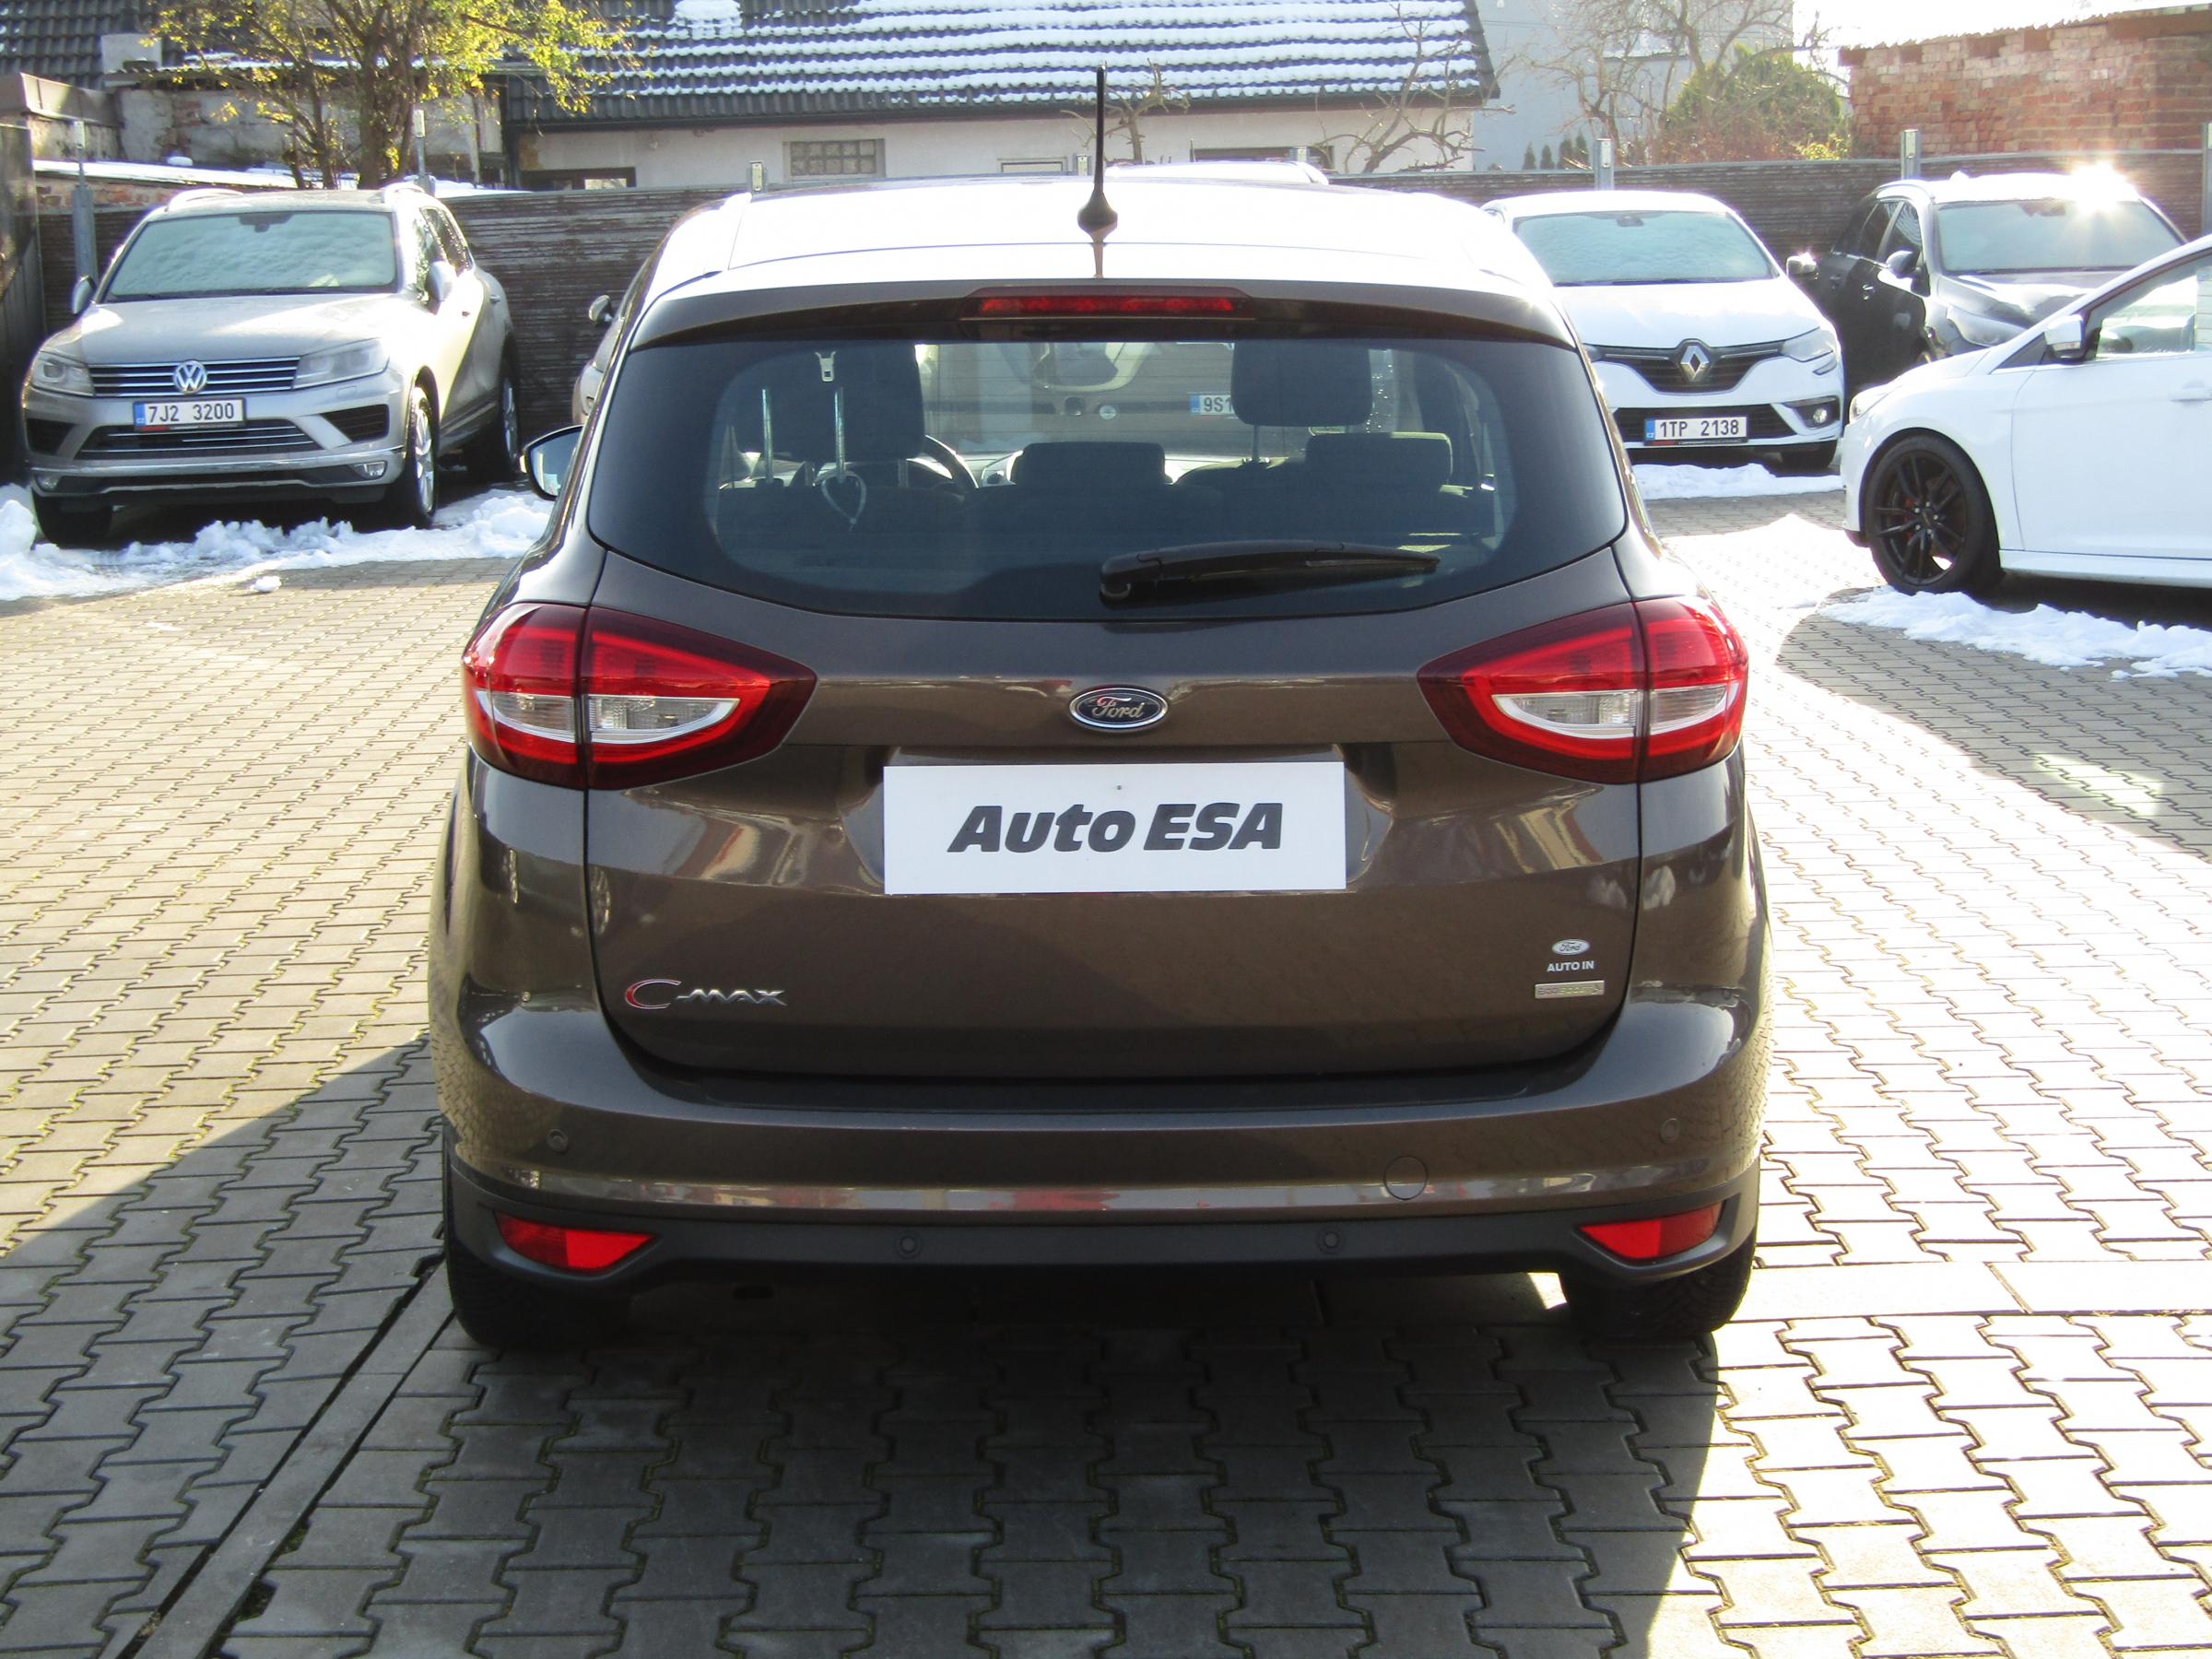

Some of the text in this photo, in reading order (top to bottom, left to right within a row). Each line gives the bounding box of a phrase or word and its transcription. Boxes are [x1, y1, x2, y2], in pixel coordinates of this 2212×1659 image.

[147, 403, 235, 423] 7J2 3200
[1660, 419, 1739, 437] 1TP 2138
[1092, 696, 1147, 718] Ford
[947, 802, 1283, 853] Auto ESA
[1547, 960, 1594, 972] AUTO IN
